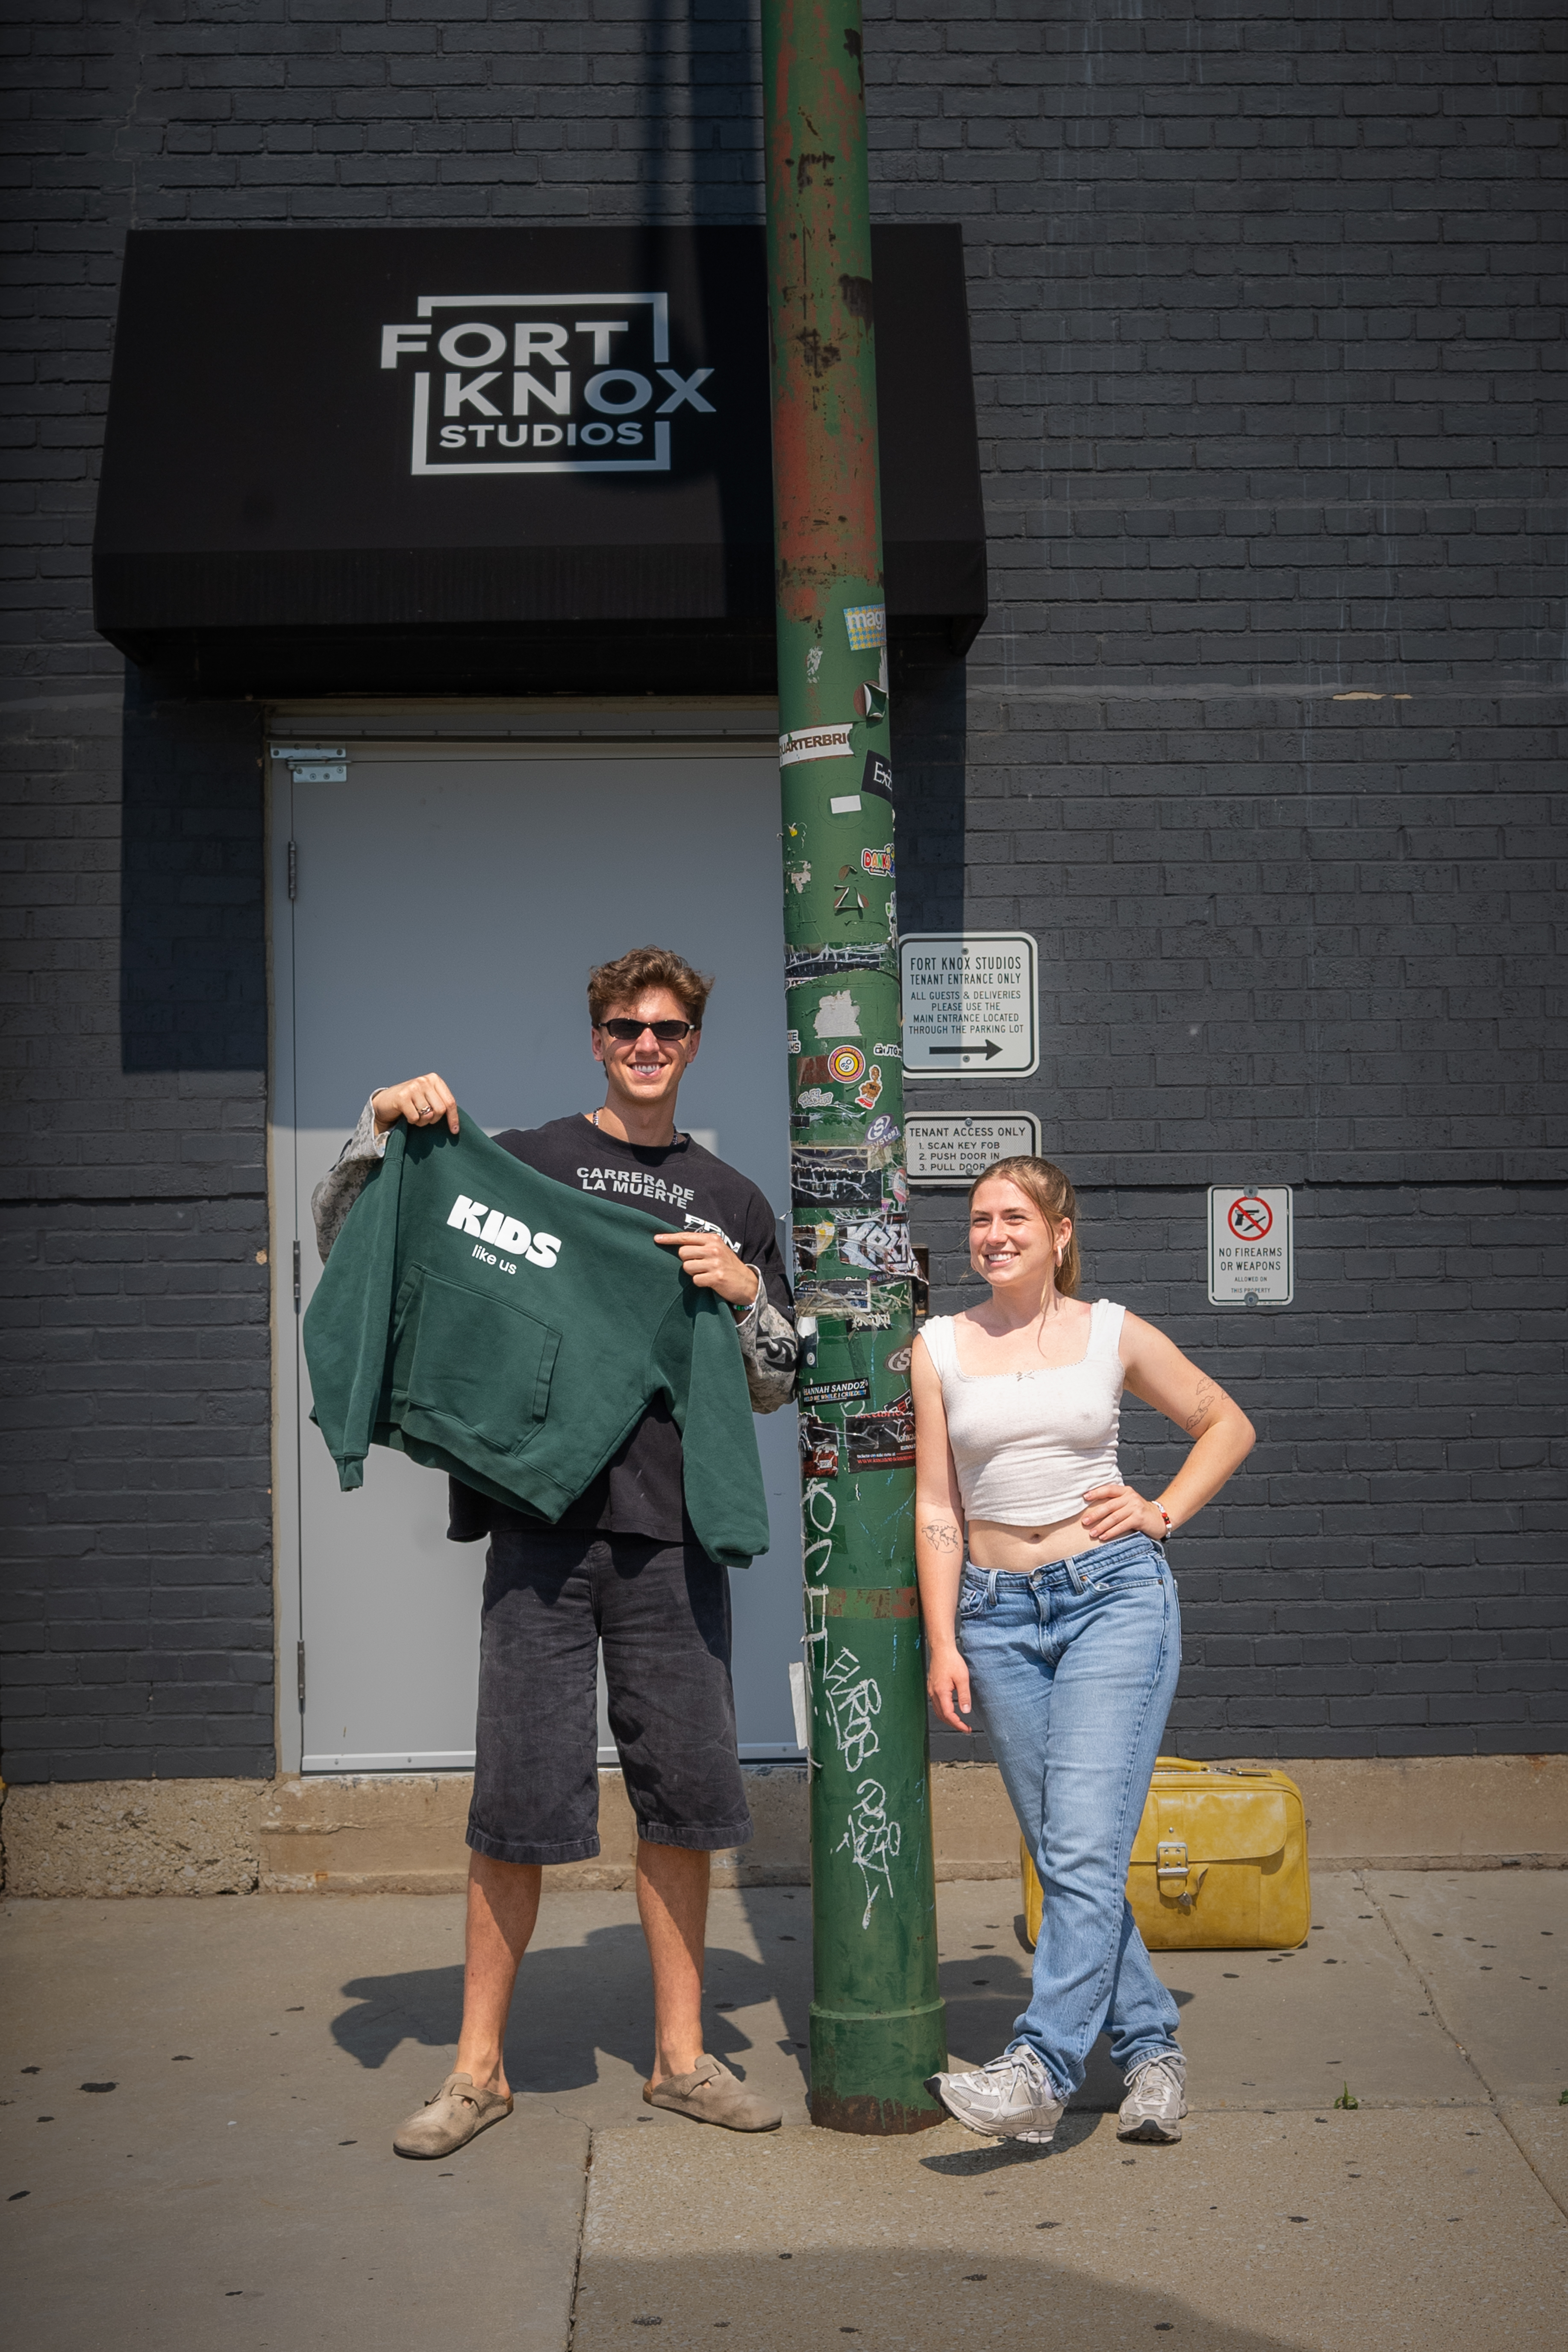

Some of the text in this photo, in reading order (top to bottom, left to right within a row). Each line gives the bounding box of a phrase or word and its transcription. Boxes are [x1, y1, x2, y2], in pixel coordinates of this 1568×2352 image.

[381, 321, 628, 368] FORT
[444, 368, 716, 417] KNOX
[439, 423, 643, 448] STUDIOS
[911, 956, 1021, 970] FORT KNOX STUDIOS
[911, 973, 1021, 985] TENANT ENTRANCE ONLY
[911, 991, 1021, 1000] ALL GUESTS & DELIVERIES
[932, 1002, 1000, 1011] PLEASE USE THE
[913, 1013, 1019, 1023] MAIN ENTRANCE LOCATED
[909, 1024, 1024, 1034] THROUGH THE PARKING LOT
[909, 1127, 1025, 1137] TENANT ACCESS ONLY
[577, 1167, 694, 1201] CARRERA DE
[582, 1178, 688, 1210] LA MUERTE
[447, 1194, 562, 1269] KIDS
[1219, 1247, 1282, 1257] NO FIREARMS
[471, 1244, 517, 1275] like us
[1221, 1261, 1281, 1270] OR WEAPONS
[803, 1381, 865, 1396] HANNAH SANDOZ
[1025, 2052, 1039, 2066] NIKE
